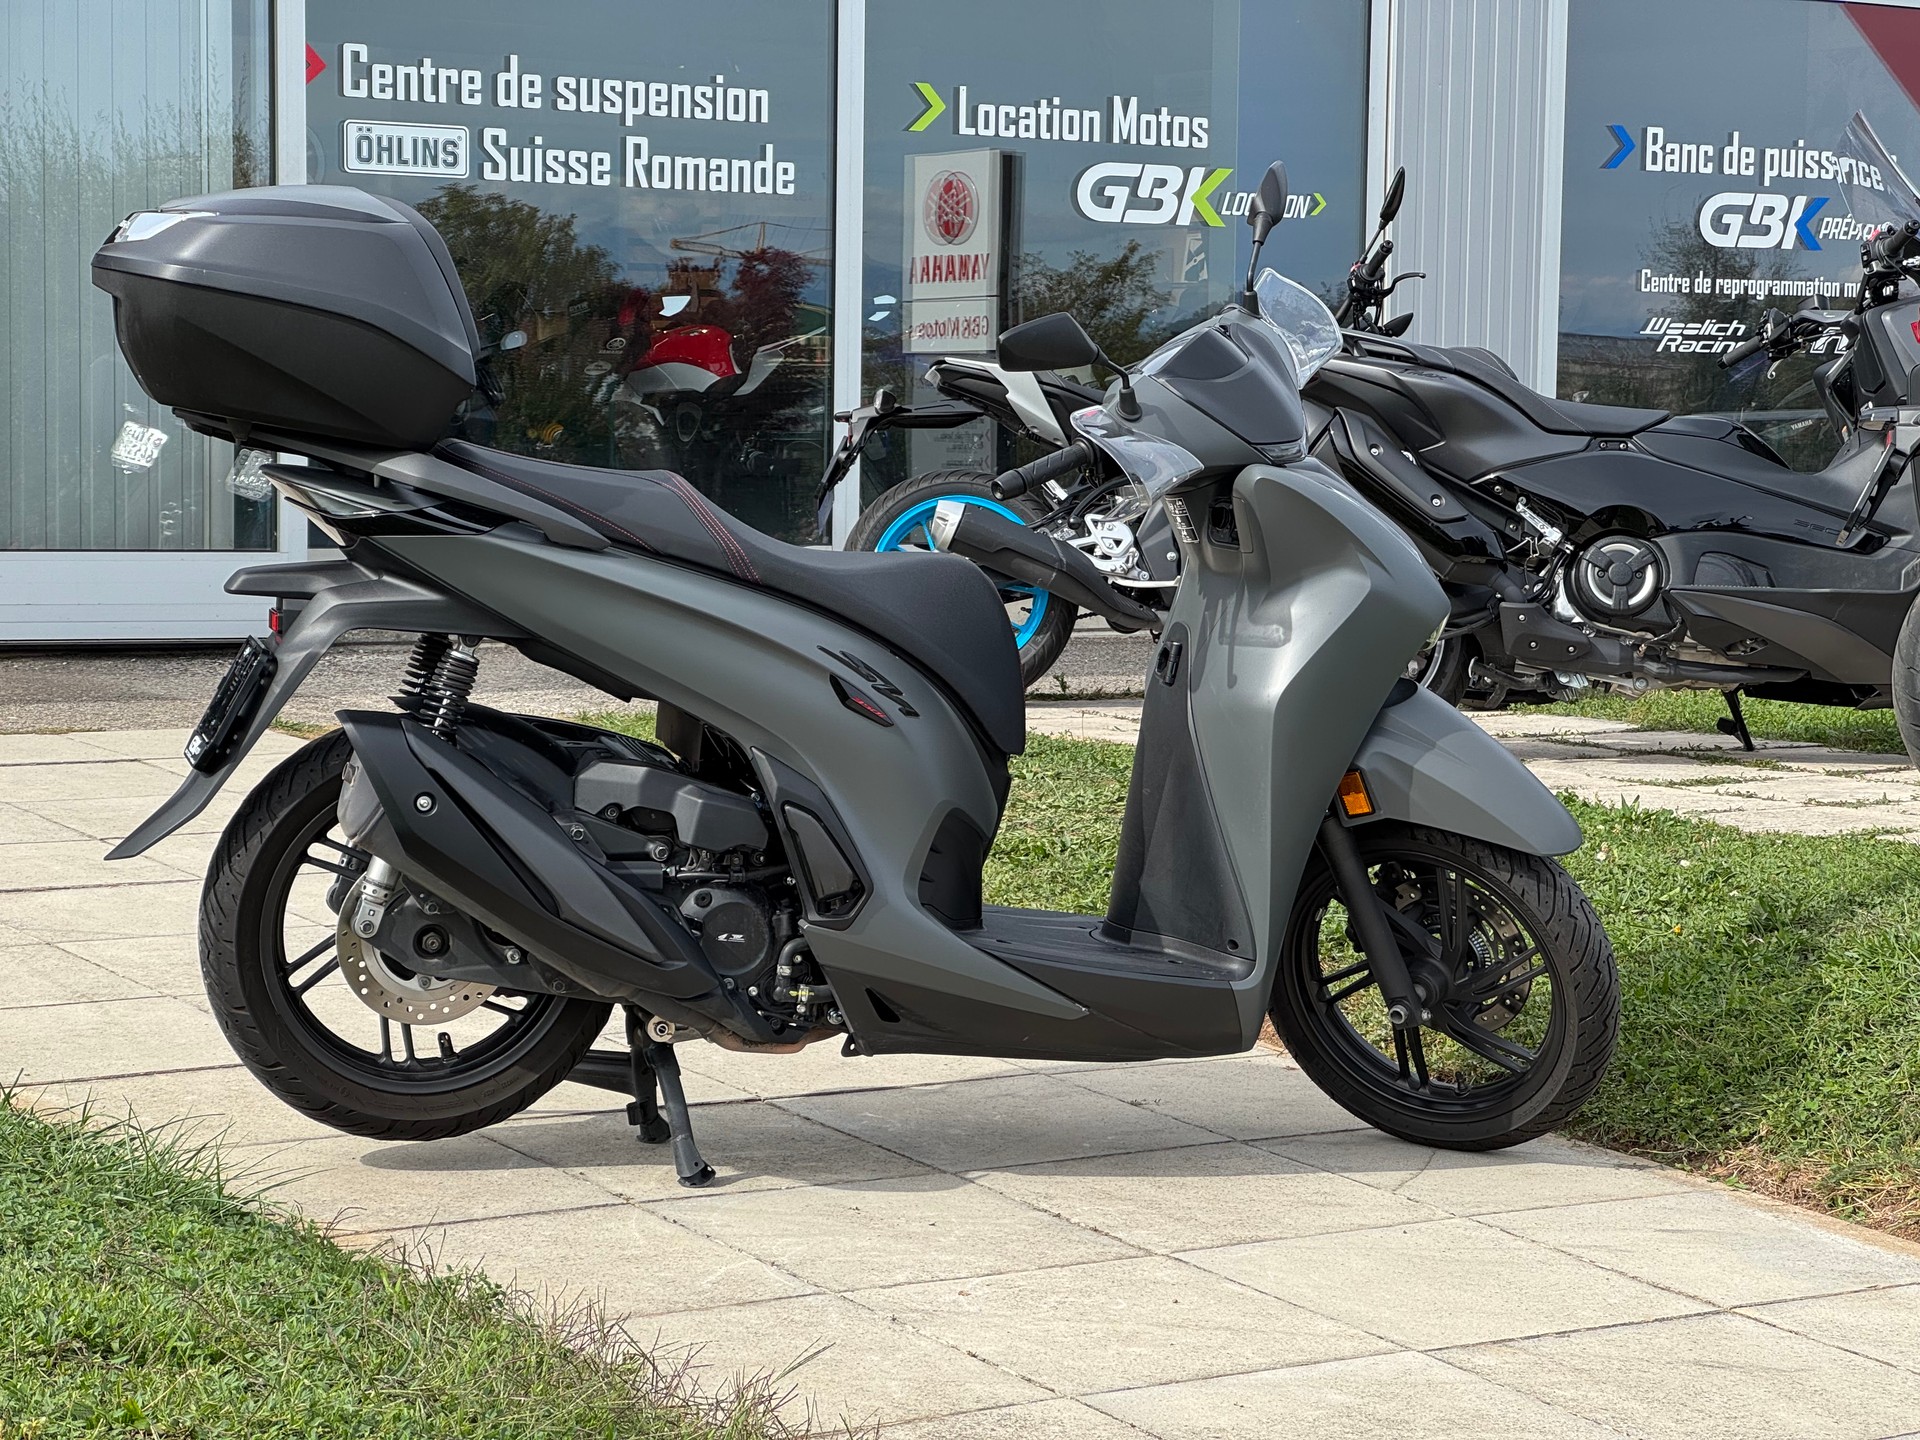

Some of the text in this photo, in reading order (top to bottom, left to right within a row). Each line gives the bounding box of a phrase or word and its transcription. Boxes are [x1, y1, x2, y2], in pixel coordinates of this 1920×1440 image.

[342, 42, 769, 126] Centre de suspension
[957, 85, 1209, 149] Location Motos
[482, 127, 795, 195] Suisse Romande
[1645, 126, 1714, 174] Banc
[1723, 131, 1755, 176] de
[1076, 161, 1233, 227] GBK
[1699, 192, 1830, 250] GBK
[1641, 269, 1690, 293] Centre
[1695, 270, 1712, 294] de
[1715, 276, 1840, 300] reprogrammation
[1791, 419, 1812, 430] YAMAHA
